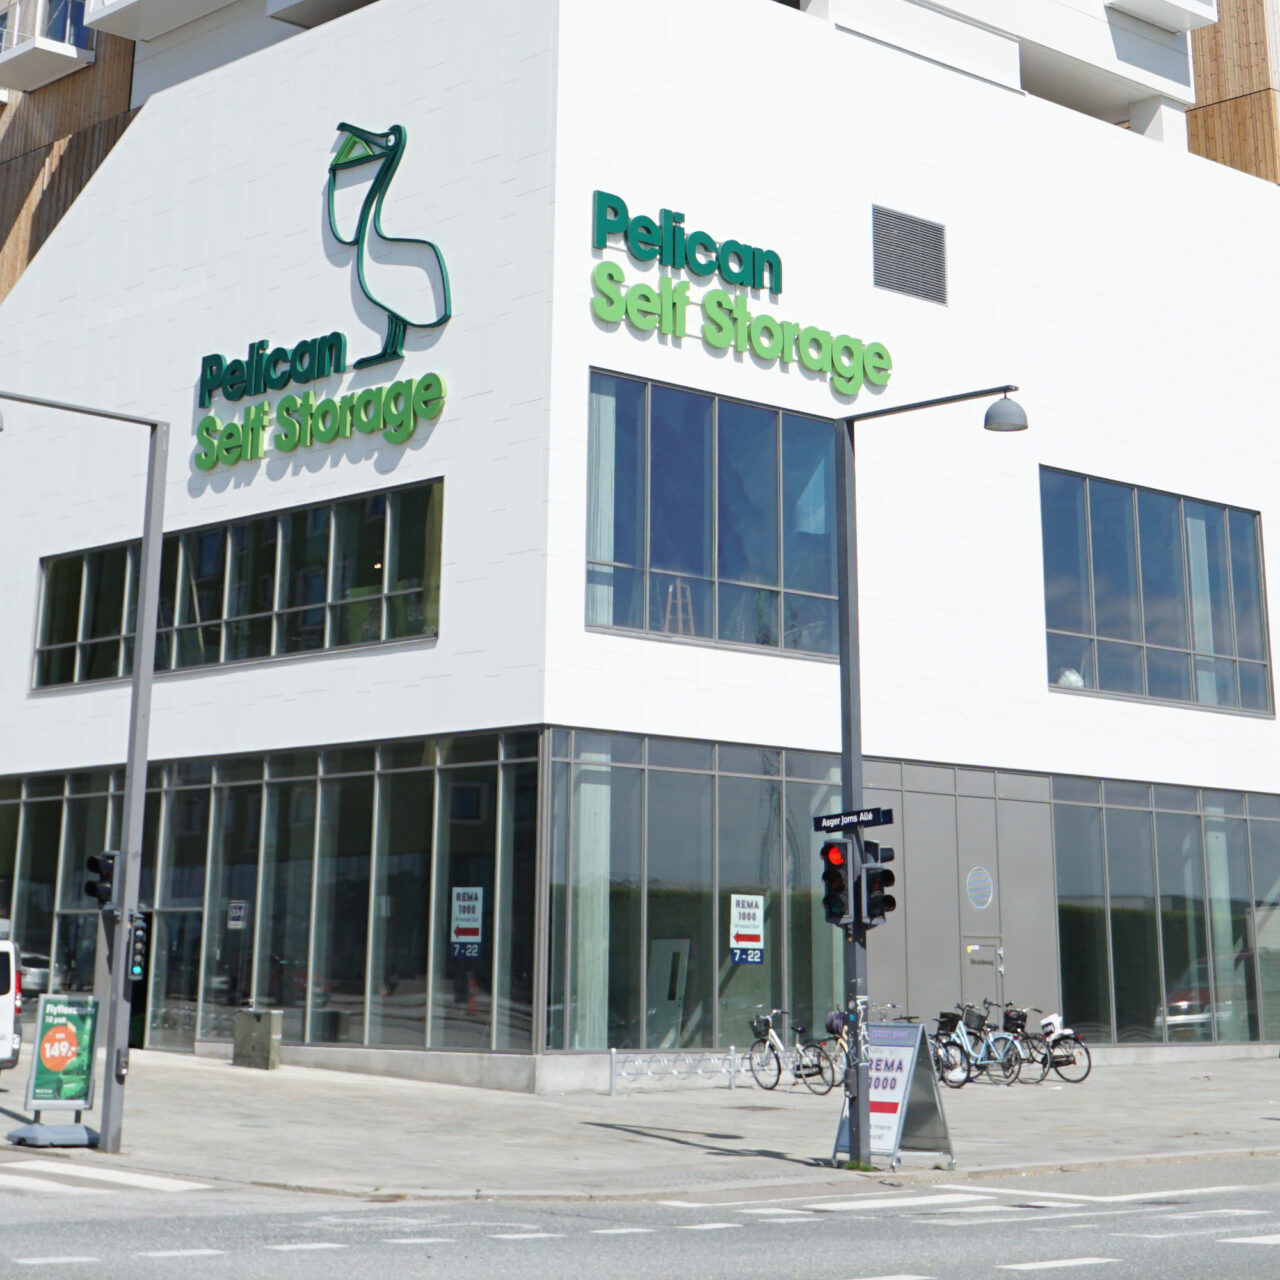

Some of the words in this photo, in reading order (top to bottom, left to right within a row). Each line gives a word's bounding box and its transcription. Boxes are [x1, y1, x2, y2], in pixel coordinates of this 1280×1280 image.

[591, 189, 783, 295] Pelican
[590, 260, 690, 339] Self
[701, 288, 893, 396] Storage
[199, 331, 347, 409] Pelican
[195, 400, 271, 471] Self
[274, 372, 448, 446] Storage
[821, 817, 841, 828] Asger
[859, 811, 873, 821] Allé
[456, 892, 479, 902] REMA
[735, 899, 760, 909] REMA
[458, 905, 476, 915] 1000
[738, 911, 757, 921] 1000
